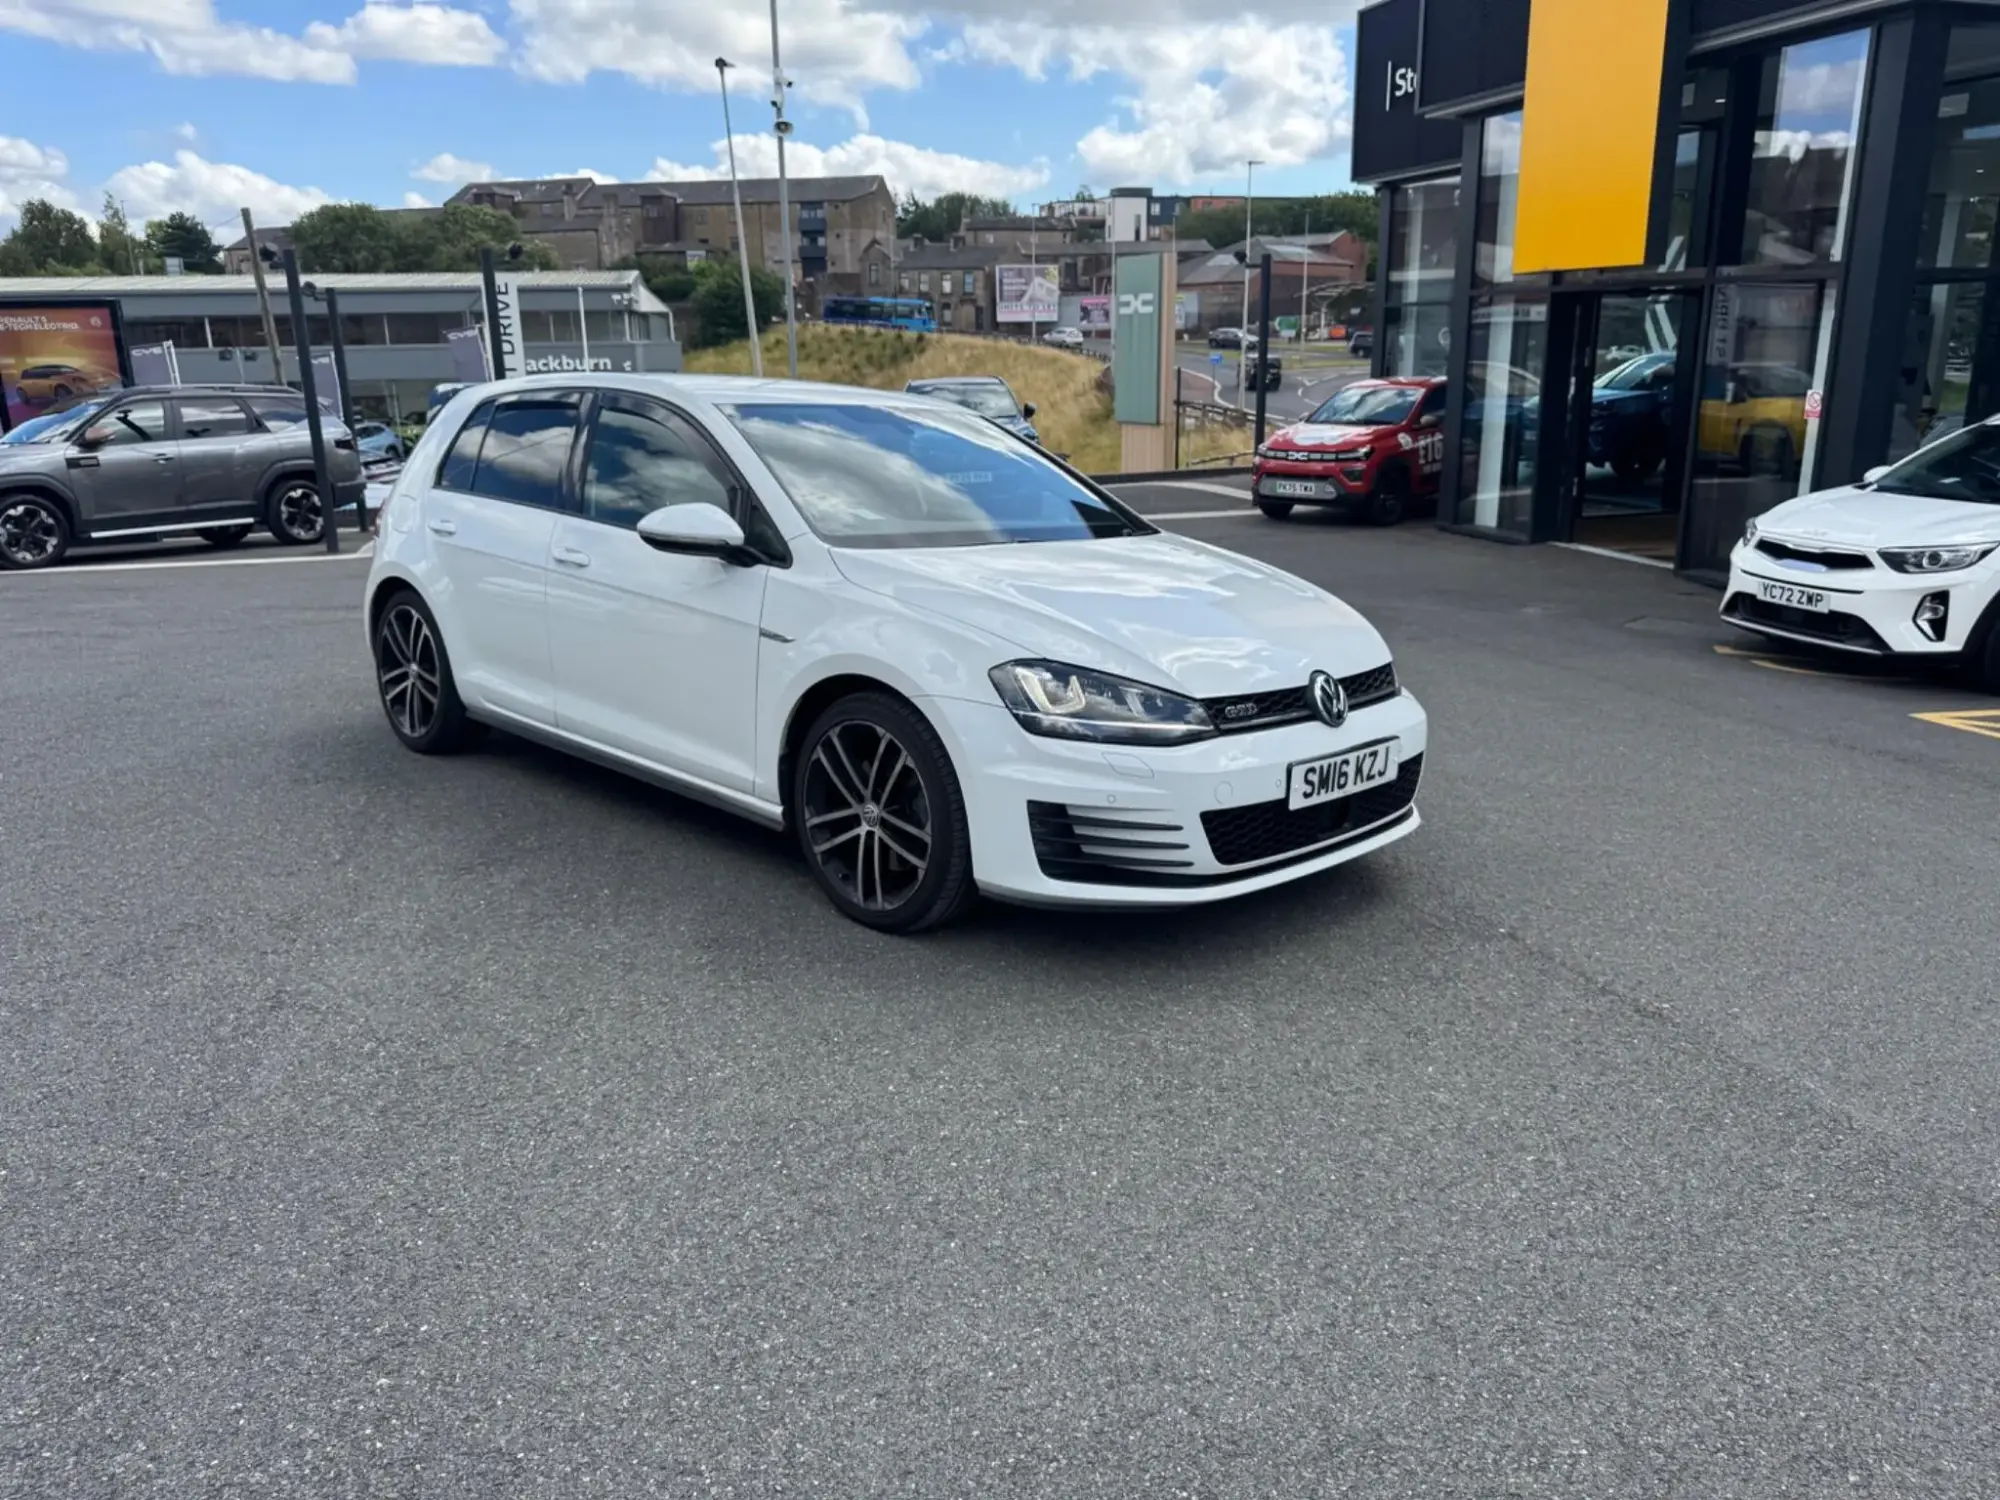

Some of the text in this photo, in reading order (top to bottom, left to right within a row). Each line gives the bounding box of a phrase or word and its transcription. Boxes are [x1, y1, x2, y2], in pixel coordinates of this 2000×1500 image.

[1762, 582, 1824, 608] YC72 ZWP
[1302, 746, 1390, 799] SM16 KZJ
